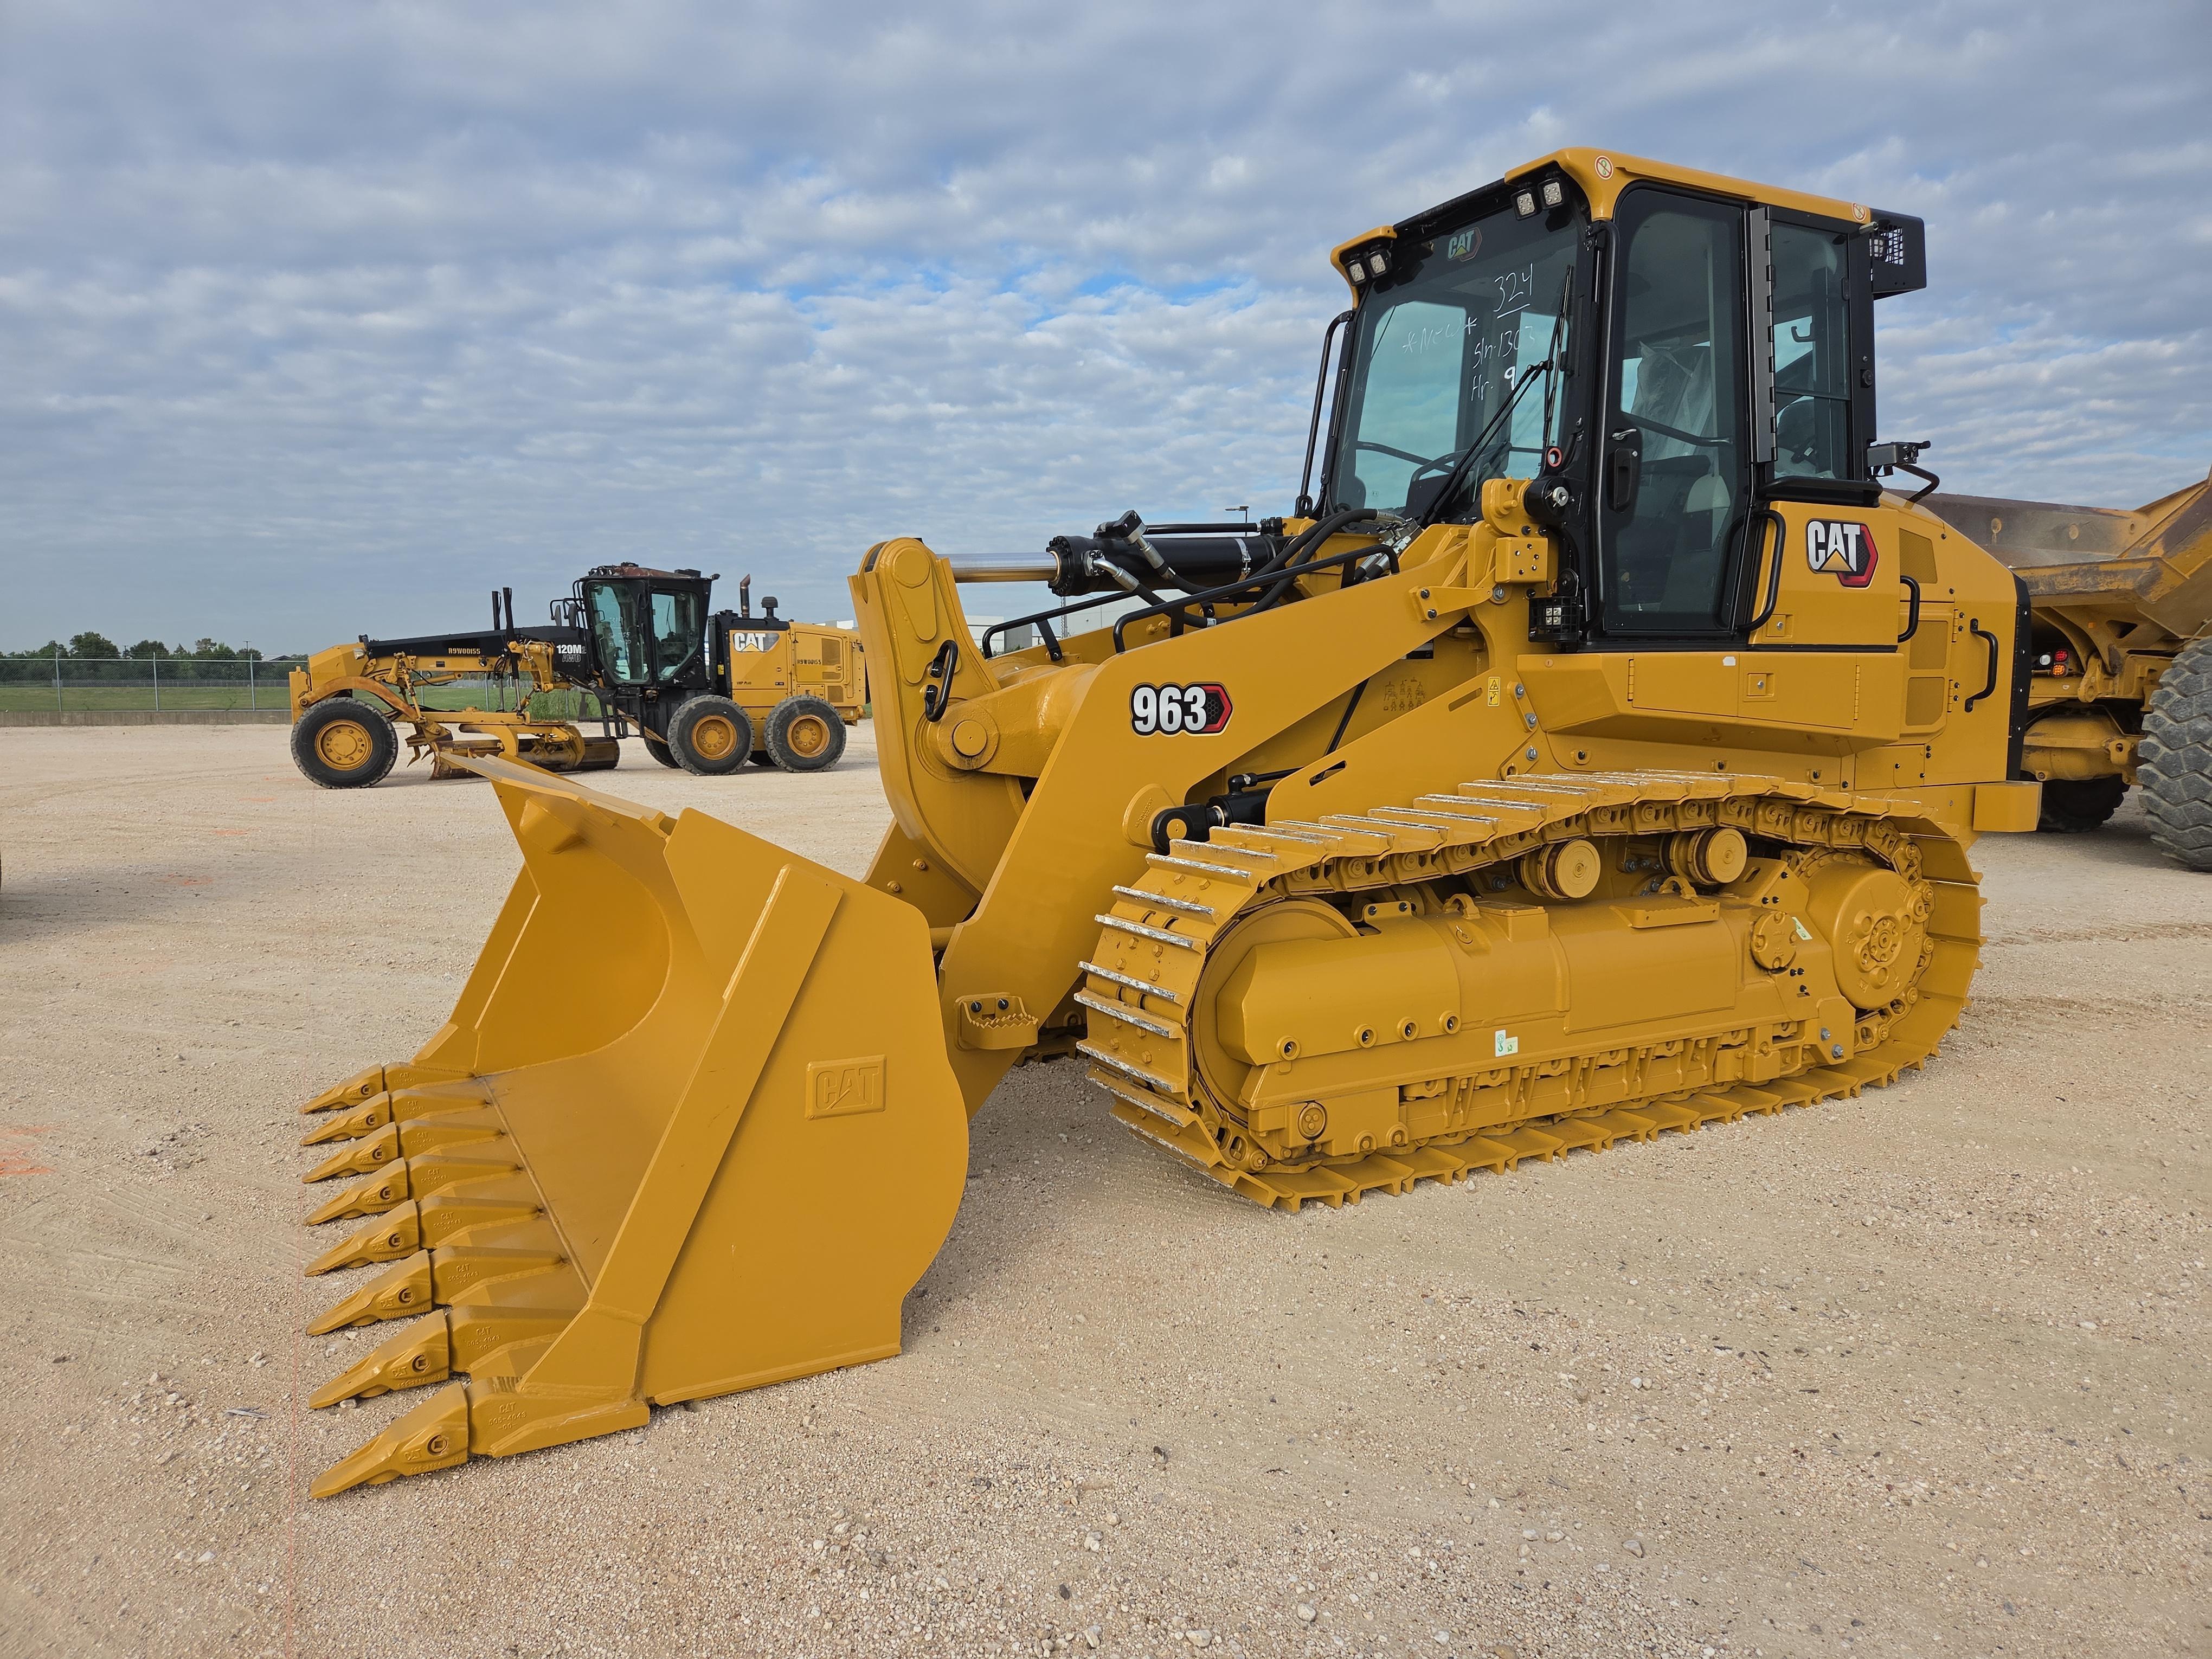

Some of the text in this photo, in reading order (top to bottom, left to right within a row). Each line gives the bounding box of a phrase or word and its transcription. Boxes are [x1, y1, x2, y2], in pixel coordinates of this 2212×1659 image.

[1448, 230, 1475, 259] CAT
[1493, 263, 1533, 312] 324
[1504, 366, 1516, 390] 9
[1808, 521, 1860, 572] CAT
[734, 633, 766, 652] CAT
[562, 654, 581, 663] AWD
[1134, 686, 1207, 732] 963
[816, 1066, 879, 1110] CAT
[440, 1212, 454, 1220] CAT
[371, 1242, 384, 1251] CAT
[456, 1263, 470, 1272] CAT
[380, 1298, 394, 1308] CAT
[476, 1326, 492, 1336] CAT
[391, 1366, 408, 1377] CAT
[499, 1401, 517, 1414] CAT
[488, 1411, 527, 1426] 505-4043
[404, 1448, 421, 1461] CAT
